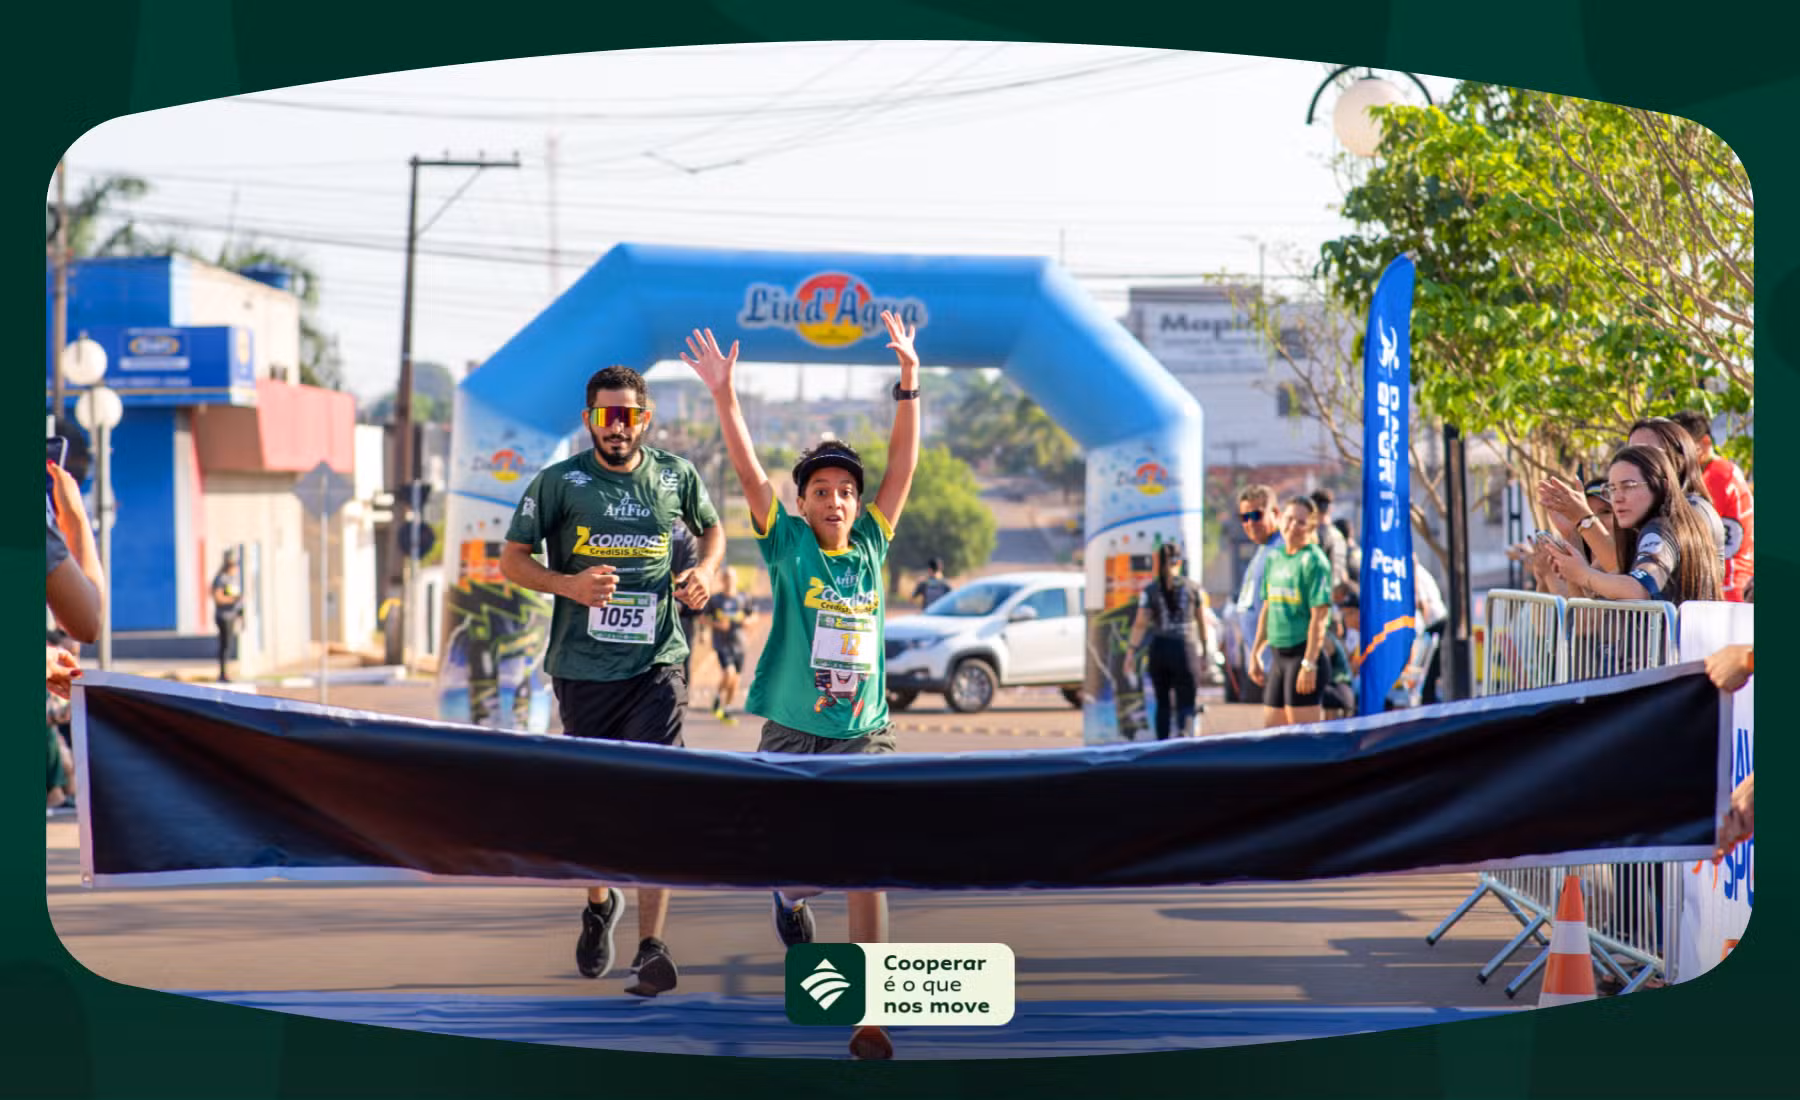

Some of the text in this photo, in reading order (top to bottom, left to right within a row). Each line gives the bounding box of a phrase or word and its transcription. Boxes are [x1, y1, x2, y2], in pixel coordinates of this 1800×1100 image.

[604, 503, 650, 517] ArtFio
[804, 576, 824, 608] 2
[600, 607, 644, 628] 1055
[841, 633, 861, 656] 12
